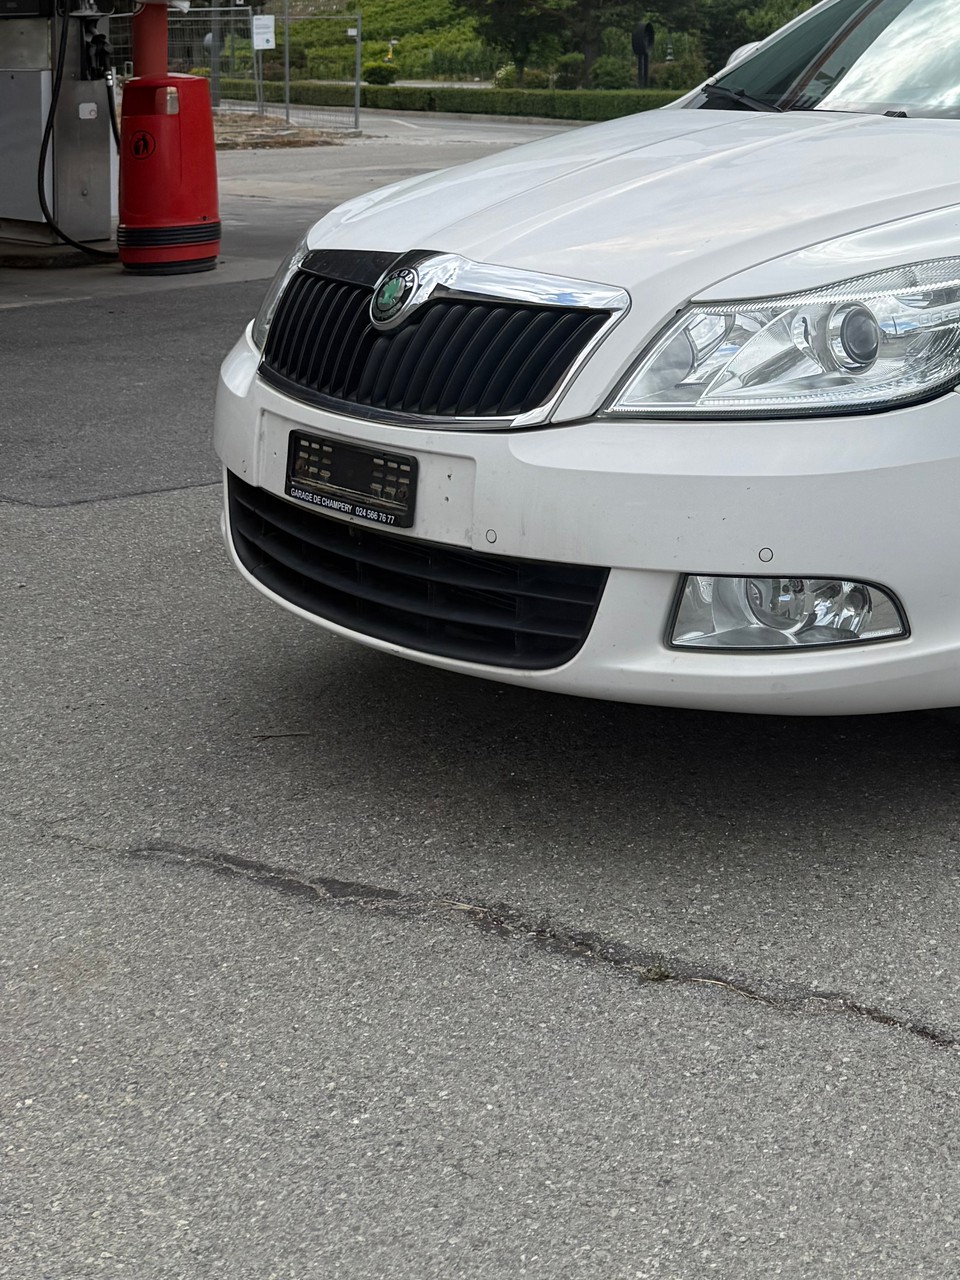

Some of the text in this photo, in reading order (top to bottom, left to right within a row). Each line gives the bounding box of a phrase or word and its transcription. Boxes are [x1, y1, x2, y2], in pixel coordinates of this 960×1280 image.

[290, 488, 395, 524] GARAGE DE CHAMPERY 024 566 76 77
